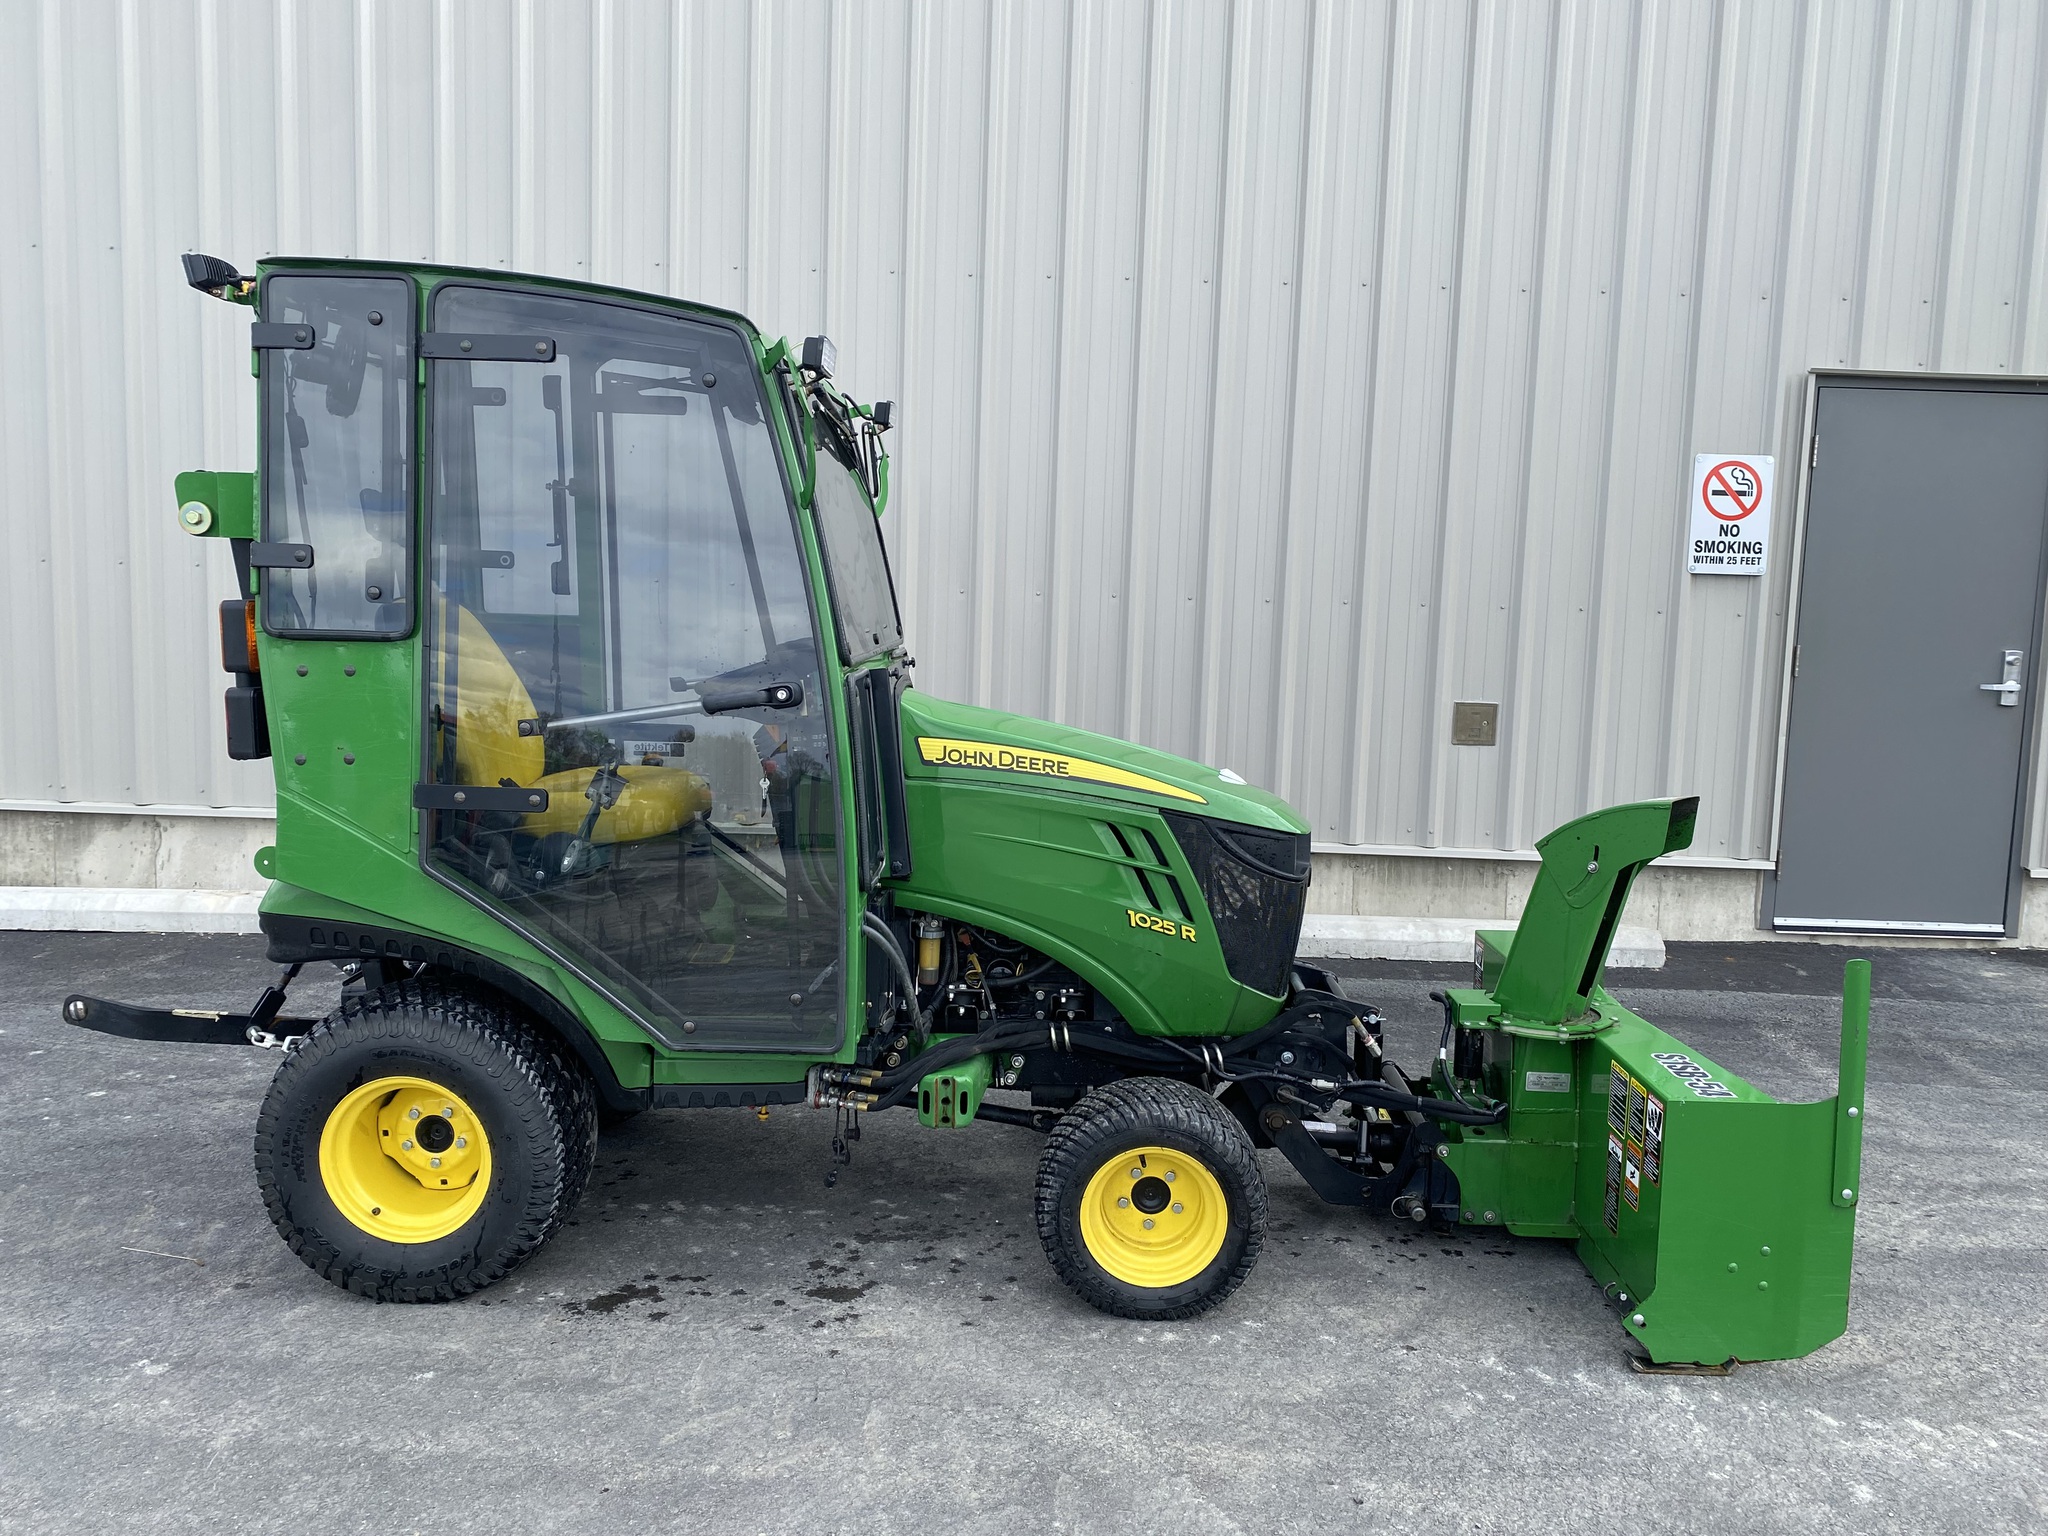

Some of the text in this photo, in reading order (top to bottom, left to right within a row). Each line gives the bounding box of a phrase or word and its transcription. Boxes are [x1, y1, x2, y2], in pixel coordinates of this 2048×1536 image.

[1719, 524, 1740, 537] NO
[1694, 540, 1763, 554] SMOKING
[1693, 555, 1762, 566] WITHIN 25 FEET
[935, 745, 1069, 775] JOHN DEERE
[1126, 909, 1197, 943] 1025 R
